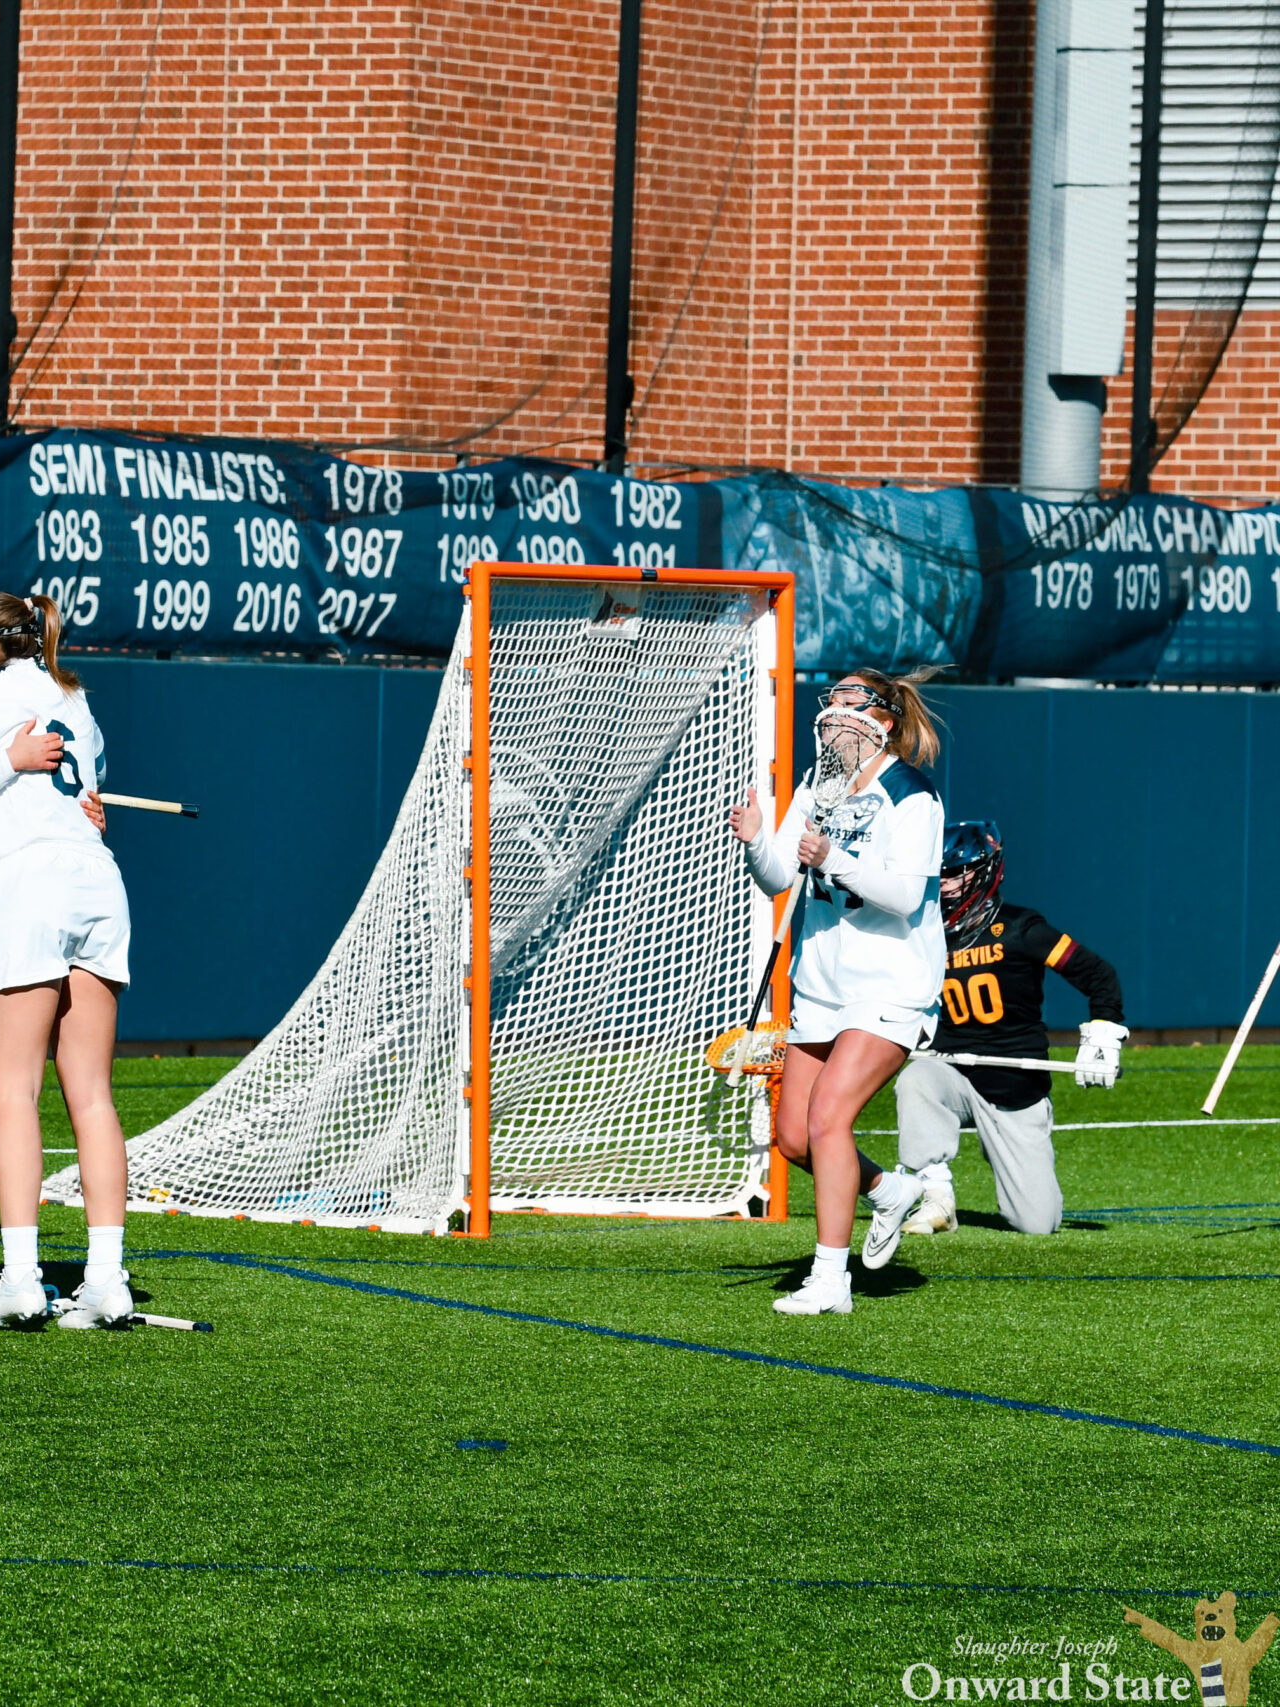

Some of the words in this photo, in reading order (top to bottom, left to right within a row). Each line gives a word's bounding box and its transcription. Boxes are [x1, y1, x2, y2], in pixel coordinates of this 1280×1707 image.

[29, 443, 107, 497] SEMI
[114, 447, 287, 505] FINALISTS:
[323, 463, 403, 516] 1978
[437, 472, 495, 521] 1979
[511, 472, 581, 525] 1980
[611, 480, 682, 530] 1982
[35, 510, 103, 562] 1983
[130, 514, 211, 567] 1985
[234, 517, 301, 570] 1986
[324, 526, 403, 578] 1987
[1021, 502, 1152, 553] NATIONAL
[134, 579, 211, 632] 1999
[233, 581, 302, 633] 2016
[318, 587, 398, 638] 2017
[1031, 561, 1094, 611] 1978
[1114, 564, 1161, 611] 1979
[1181, 565, 1252, 613] 1980
[953, 942, 1004, 969] DEVILS
[942, 972, 1004, 1025] 00
